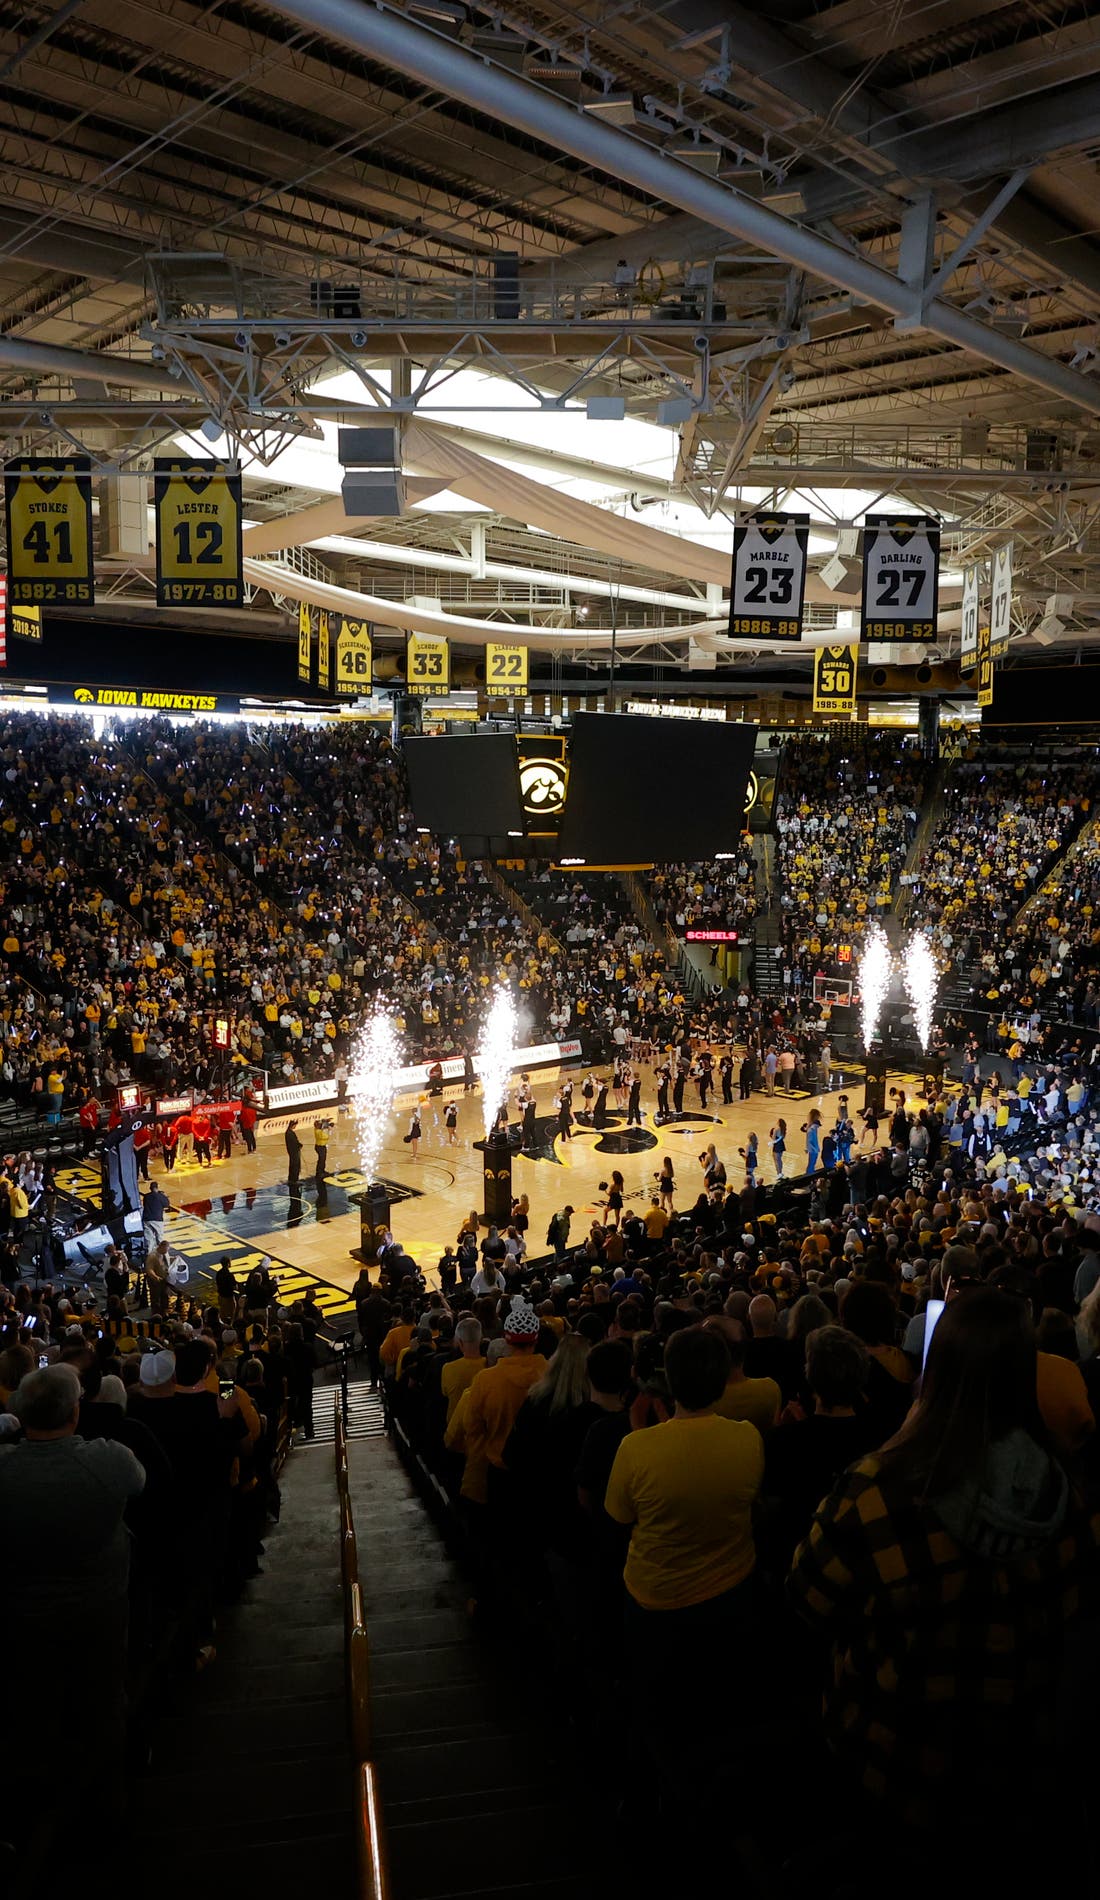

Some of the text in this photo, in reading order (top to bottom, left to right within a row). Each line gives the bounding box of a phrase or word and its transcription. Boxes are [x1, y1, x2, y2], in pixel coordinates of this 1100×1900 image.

[28, 502, 68, 514] STOKES
[176, 502, 219, 515] LESTER
[23, 520, 73, 564] 41
[173, 521, 223, 564] 12
[750, 551, 790, 563] MARBLE
[880, 553, 923, 565] DARLING
[13, 582, 90, 600] 1982-85
[163, 583, 238, 600] 1977-80
[743, 567, 795, 604] 23
[876, 569, 927, 607] 27
[995, 592, 1008, 628] 17
[12, 618, 41, 639] 2018-21
[733, 619, 798, 636] 1986-89
[865, 623, 933, 638] 1950-52
[964, 607, 975, 641] 10
[341, 651, 367, 675] 46
[413, 653, 442, 676] 33
[492, 654, 522, 677] 22
[337, 683, 371, 694] 1954-56
[407, 685, 449, 696] 1954-56
[821, 670, 850, 693] 30
[97, 689, 216, 710] IOWA HAWKEYES
[486, 686, 528, 697] 1954-56
[816, 700, 853, 709] 1985-88
[686, 930, 737, 940] SCHEELS
